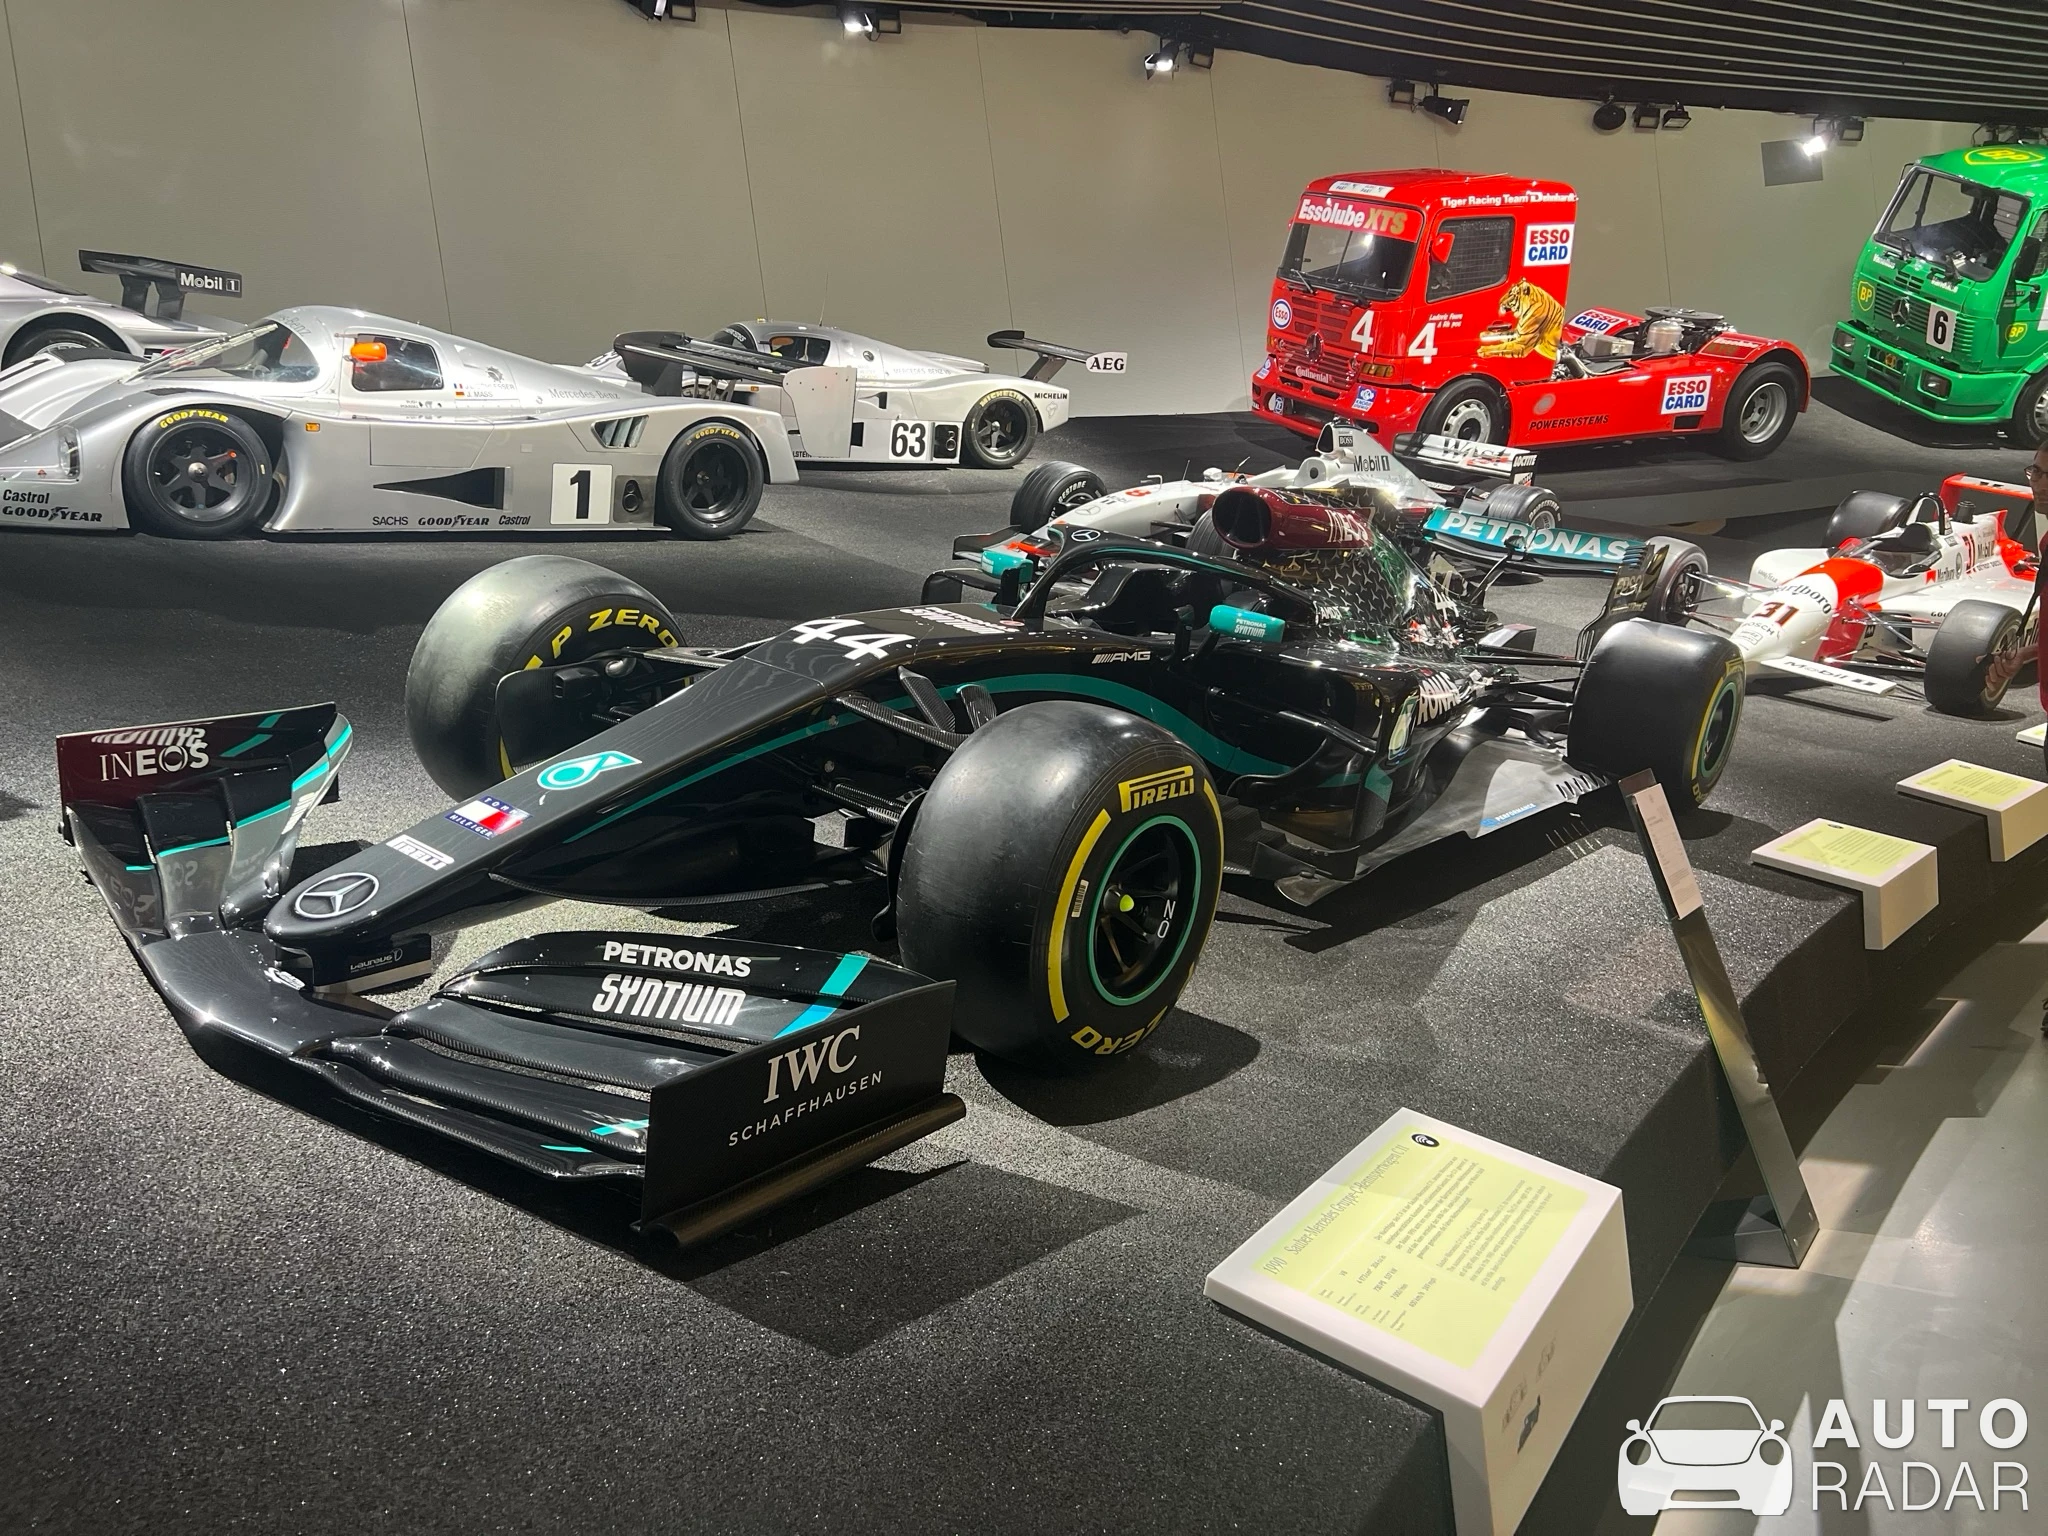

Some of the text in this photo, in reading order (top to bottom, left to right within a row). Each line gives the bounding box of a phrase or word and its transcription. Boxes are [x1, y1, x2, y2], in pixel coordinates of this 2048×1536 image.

[1440, 197, 1467, 208] Tiger
[1468, 195, 1502, 206] Racing
[1503, 194, 1529, 203] Team
[1363, 208, 1408, 234] XTS
[1530, 229, 1570, 245] ESSO
[1528, 246, 1568, 261] CARD
[180, 272, 240, 292] Mobil 1
[1861, 286, 1872, 301] BP
[1274, 307, 1290, 320] Esso
[1584, 310, 1620, 323] ESSO
[1351, 310, 1374, 352] 4
[1574, 315, 1609, 333] CARD
[1934, 311, 1949, 344] 6
[2009, 327, 2025, 338] BP
[1409, 322, 1438, 364] 4
[1089, 357, 1124, 370] AEG
[1295, 365, 1329, 383] Continental
[548, 389, 620, 400] Mercedes-Benz
[1668, 380, 1707, 395] ESSO
[1665, 394, 1705, 410] CARD
[1529, 415, 1609, 431] POWERSYSTEMS
[891, 422, 926, 458] 63
[1340, 437, 1353, 445] BOSS
[1354, 455, 1390, 472] Mobil 1
[1513, 454, 1537, 467] LOCTITE
[3, 489, 49, 504] Castrol
[570, 470, 591, 519] 1
[2, 506, 103, 523] GOODYEAR
[373, 515, 530, 527] SACHS GOODYEAR Castrol
[1441, 511, 1630, 562] PETRONAS
[1236, 618, 1267, 628] PETRONAS
[1752, 601, 1799, 627] 31
[551, 607, 680, 658] P ZERO
[790, 617, 919, 660] 44
[1234, 625, 1266, 638] SYNTIUM
[1103, 651, 1151, 664] AMG
[1783, 661, 1848, 679] Mobil
[100, 742, 209, 781] INEOS
[1118, 765, 1195, 813] PIRELLI
[450, 814, 494, 838] HILFIGER
[385, 834, 455, 871] PIRELLI
[603, 940, 752, 978] PETRONAS
[592, 973, 747, 1026] SYNTIUM
[763, 1025, 861, 1104] IWC
[728, 1070, 883, 1147] SCHAFFHAUSEN
[1261, 1255, 1289, 1275] 1990
